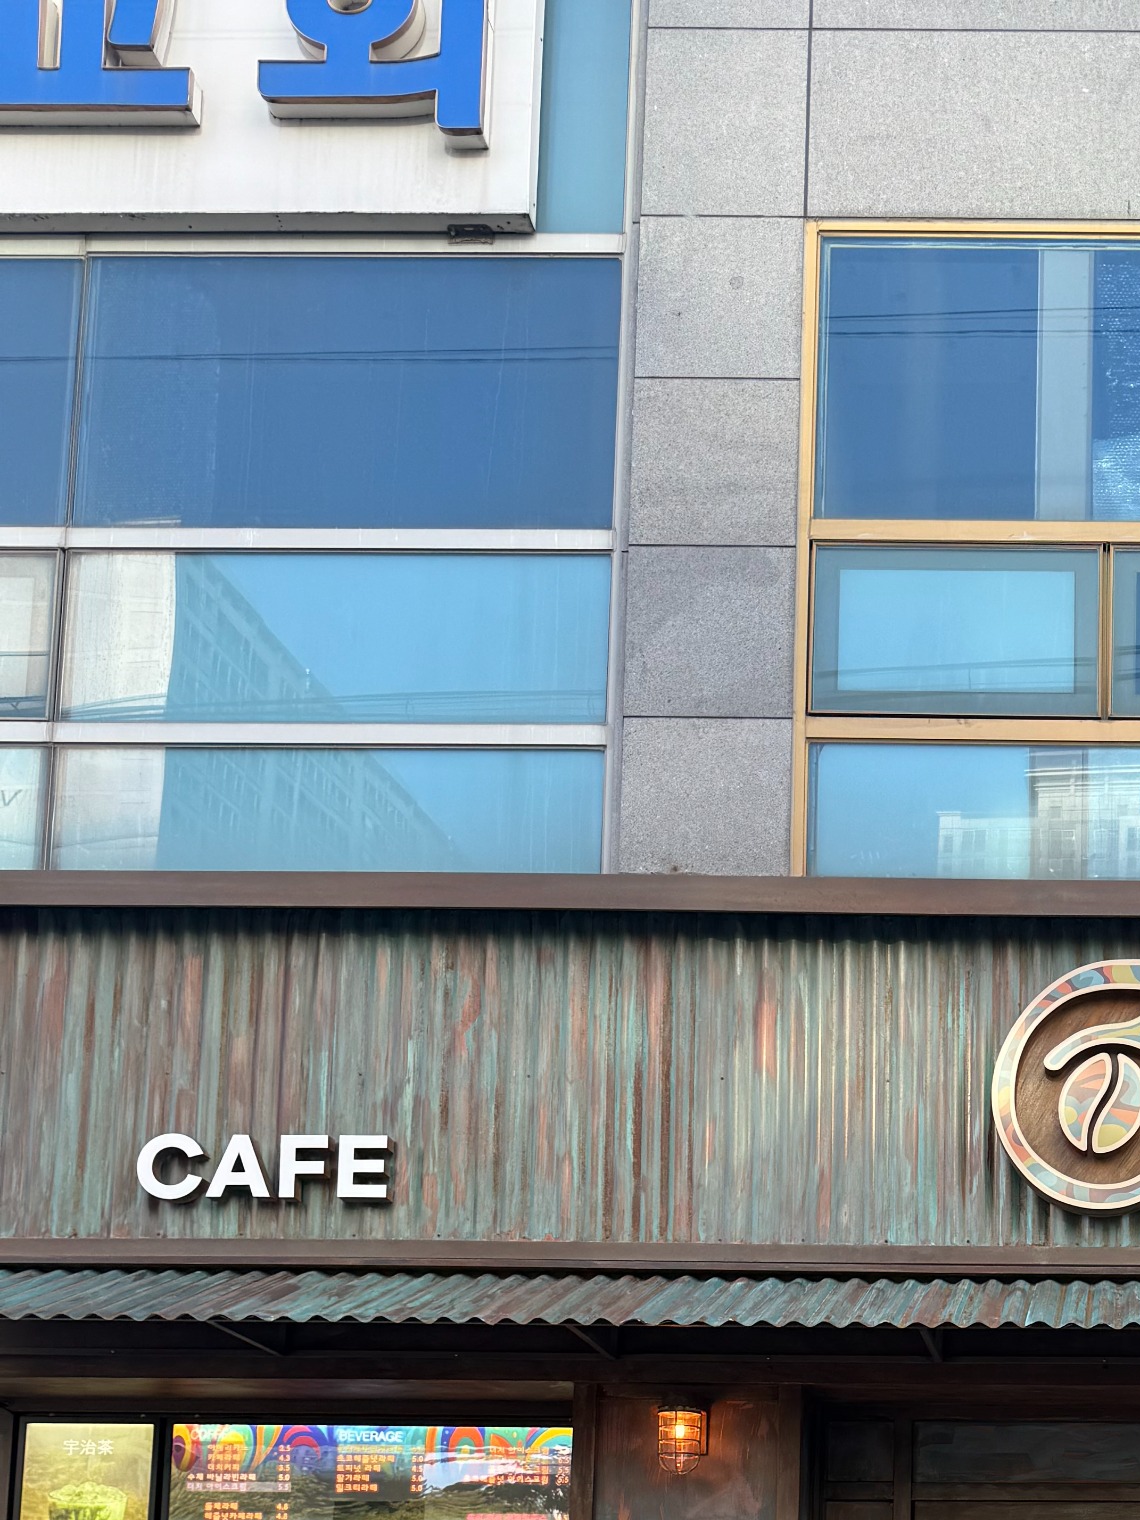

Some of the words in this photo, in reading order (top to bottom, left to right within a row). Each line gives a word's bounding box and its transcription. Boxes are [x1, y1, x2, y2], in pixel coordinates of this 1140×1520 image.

[136, 1132, 393, 1201] CAFE
[339, 1430, 403, 1442] BEVERAGE
[63, 1439, 114, 1456] 宇治茶
[411, 1455, 424, 1463] 5.0
[278, 1473, 290, 1481] 5.0
